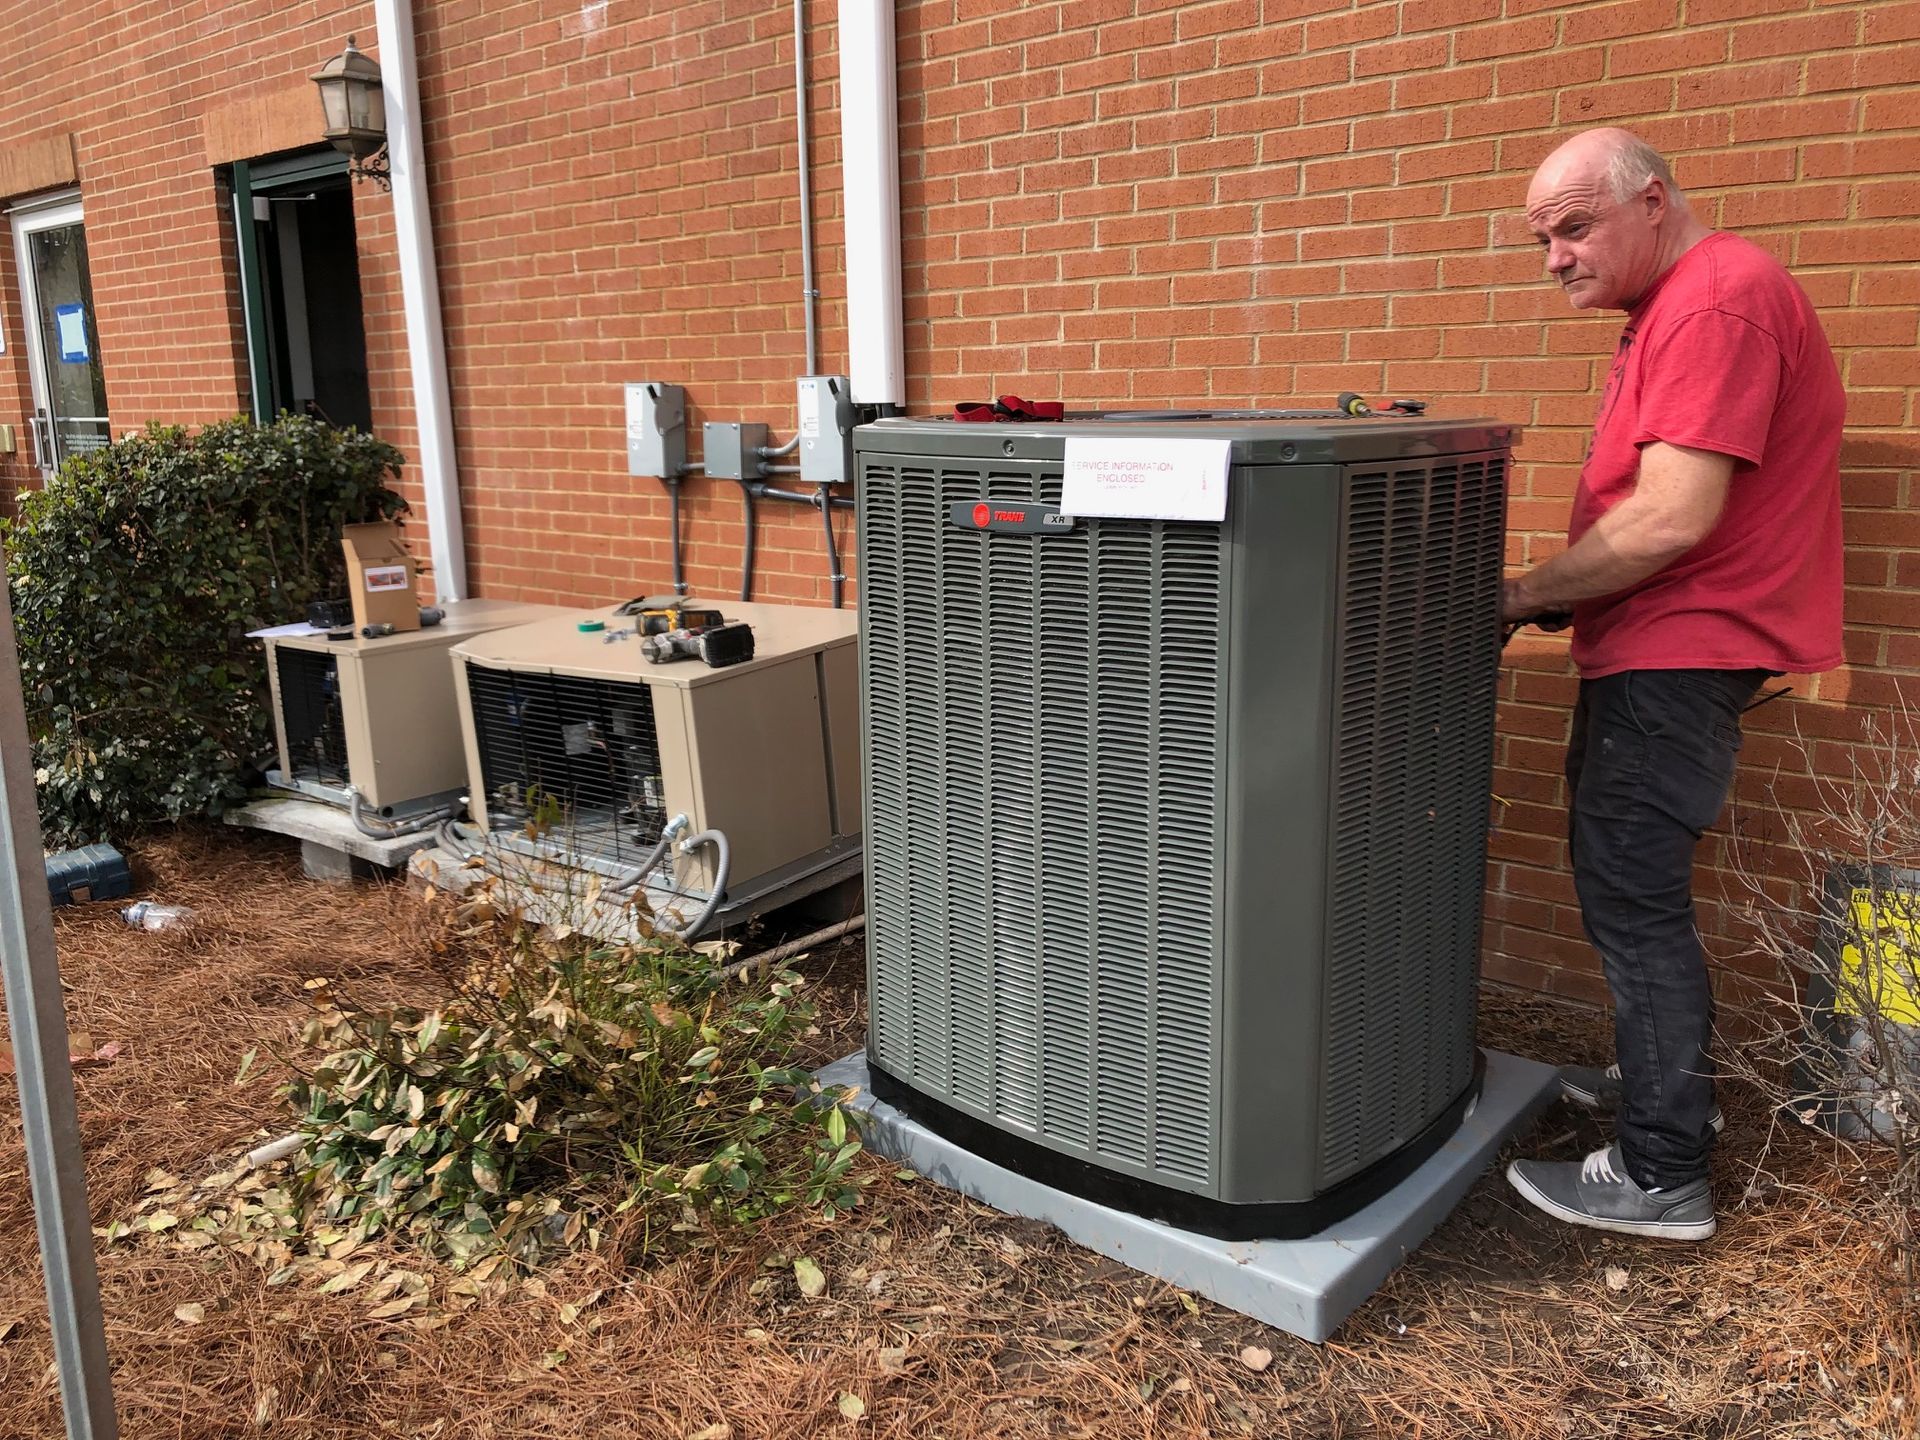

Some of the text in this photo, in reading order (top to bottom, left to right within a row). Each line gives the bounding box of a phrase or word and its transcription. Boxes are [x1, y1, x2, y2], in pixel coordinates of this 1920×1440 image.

[1071, 461, 1174, 471] SERVICE INFORMATION
[1097, 473, 1145, 483] ENCLOSED
[1051, 516, 1066, 524] XR
